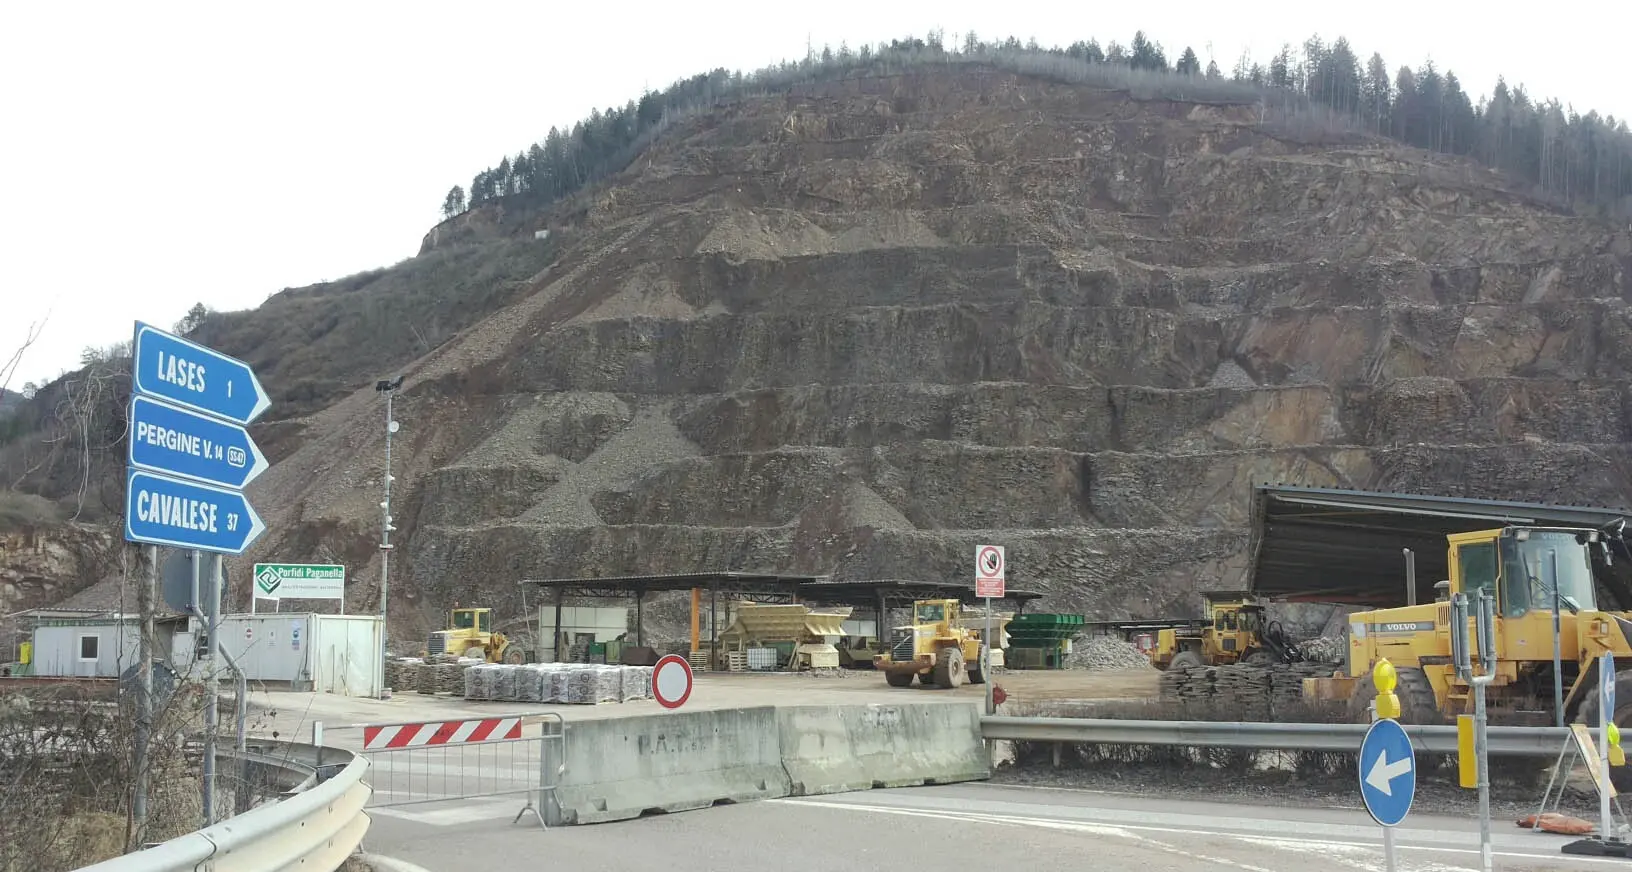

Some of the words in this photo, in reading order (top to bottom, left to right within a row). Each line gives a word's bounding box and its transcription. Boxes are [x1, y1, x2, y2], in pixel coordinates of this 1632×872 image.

[158, 351, 206, 393] LASES
[227, 380, 232, 398] 1
[137, 421, 201, 457] PERGINE
[203, 439, 213, 460] V.
[215, 445, 223, 461] 14
[138, 489, 218, 533] CAVALESE
[227, 513, 239, 532] 37
[279, 567, 304, 577] Porfidi
[306, 568, 343, 579] Paganella
[1386, 623, 1417, 631] VOLVO
